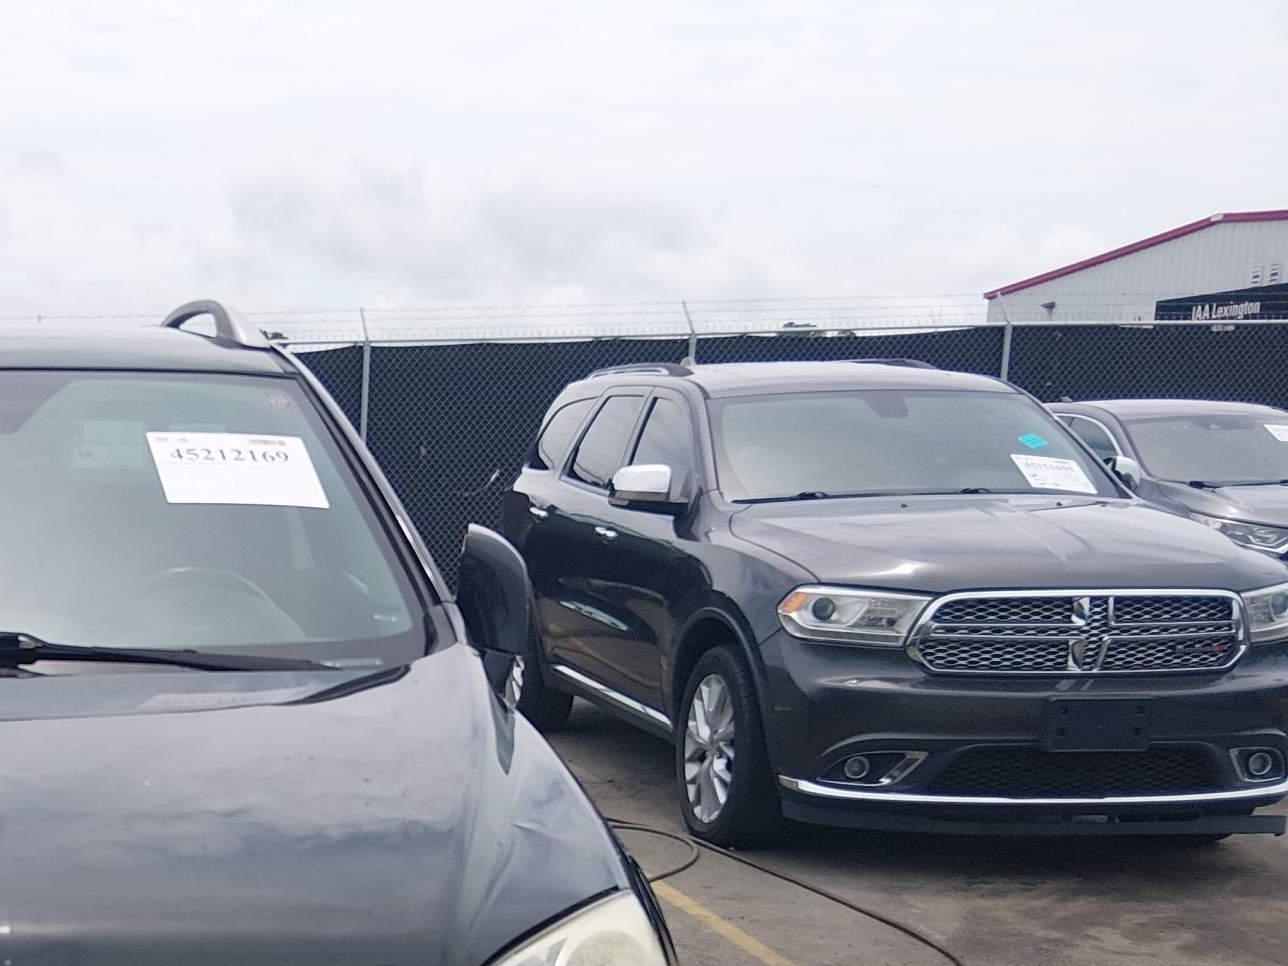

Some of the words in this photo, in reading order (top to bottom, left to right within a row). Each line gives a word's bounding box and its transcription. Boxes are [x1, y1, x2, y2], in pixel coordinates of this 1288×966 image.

[1192, 303, 1210, 321] IAA
[1212, 301, 1261, 320] Lexington
[169, 447, 290, 464] 45212169
